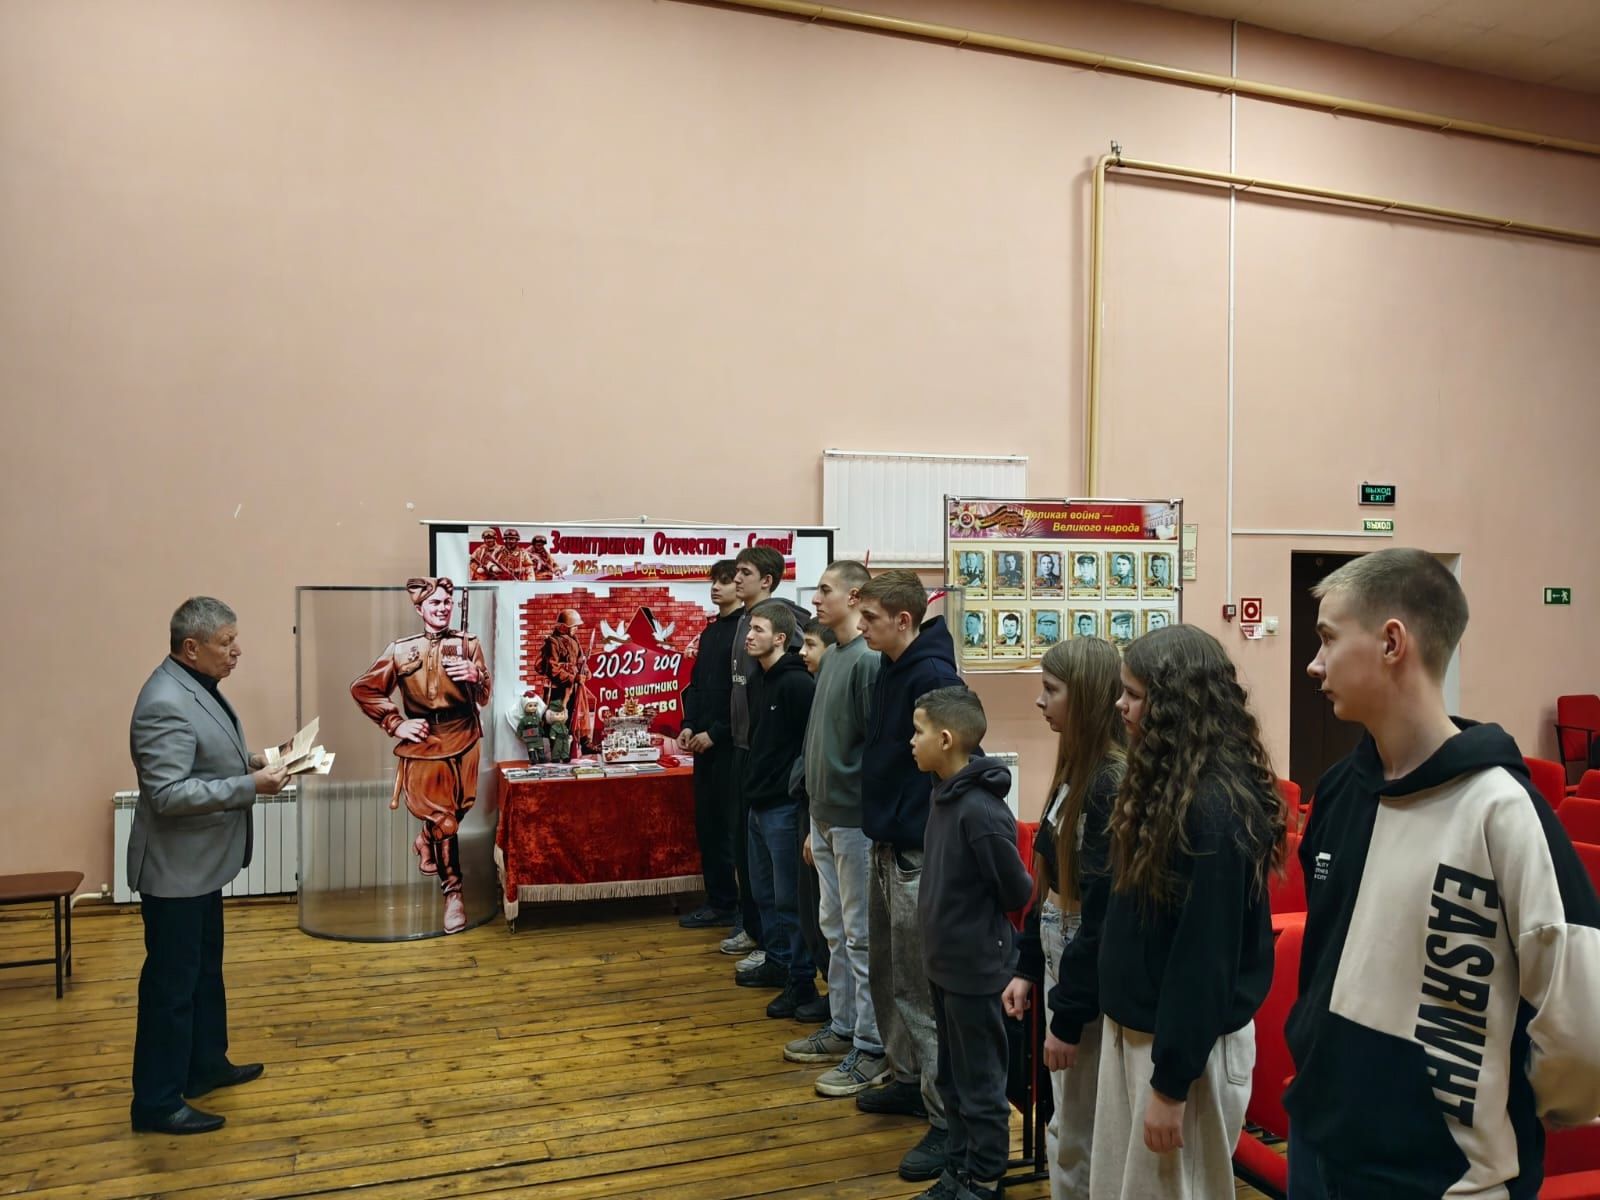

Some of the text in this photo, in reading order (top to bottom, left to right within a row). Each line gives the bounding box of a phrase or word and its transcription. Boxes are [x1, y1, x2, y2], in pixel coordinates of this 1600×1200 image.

[1365, 487, 1391, 495] ВЫХОД
[1023, 509, 1067, 519] Великая
[1070, 511, 1100, 520] война
[1052, 522, 1140, 533] Великого народа
[1366, 521, 1391, 530] ВЫХОД
[653, 531, 727, 555] Отечества
[572, 560, 598, 575] 2025
[602, 565, 623, 576] год
[634, 562, 657, 576] Год
[660, 565, 712, 576] защитни
[593, 649, 681, 678] 2025 год
[600, 687, 618, 702] Год
[1414, 863, 1499, 1128] EASRWHT
